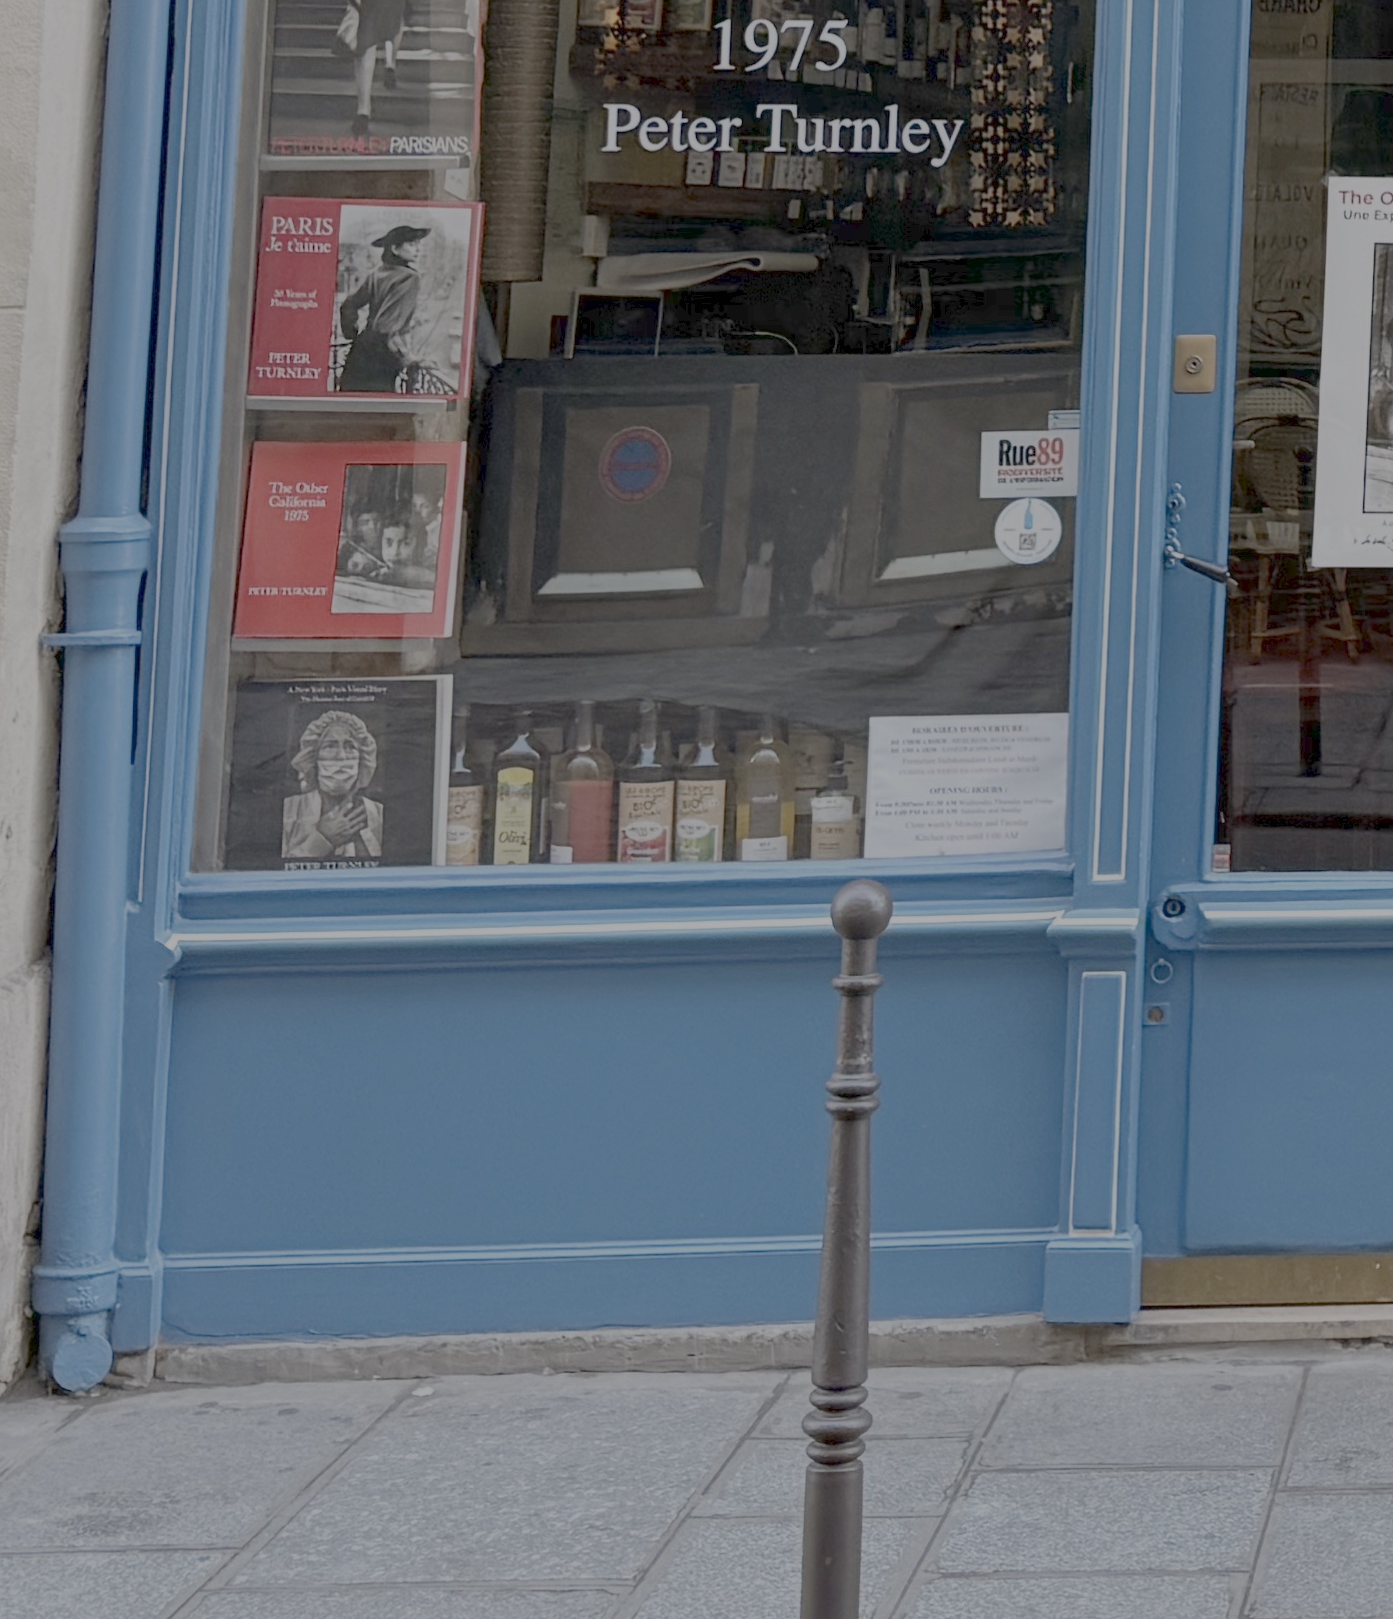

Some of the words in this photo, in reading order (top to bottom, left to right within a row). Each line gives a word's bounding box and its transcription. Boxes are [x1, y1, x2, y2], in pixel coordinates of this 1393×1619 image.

[712, 17, 849, 72] 1975
[601, 102, 744, 154] Peter
[755, 102, 965, 167] Turnley
[390, 135, 469, 154] PARISIANS
[1338, 190, 1375, 207] The
[1343, 210, 1370, 221] Une
[271, 216, 334, 236] PARIS
[265, 237, 283, 252] Je
[269, 352, 311, 365] PETER
[256, 366, 322, 380] TURNLEY
[998, 438, 1064, 467] Rue89
[268, 481, 293, 494] The
[295, 481, 329, 494] Other
[268, 495, 327, 508] California
